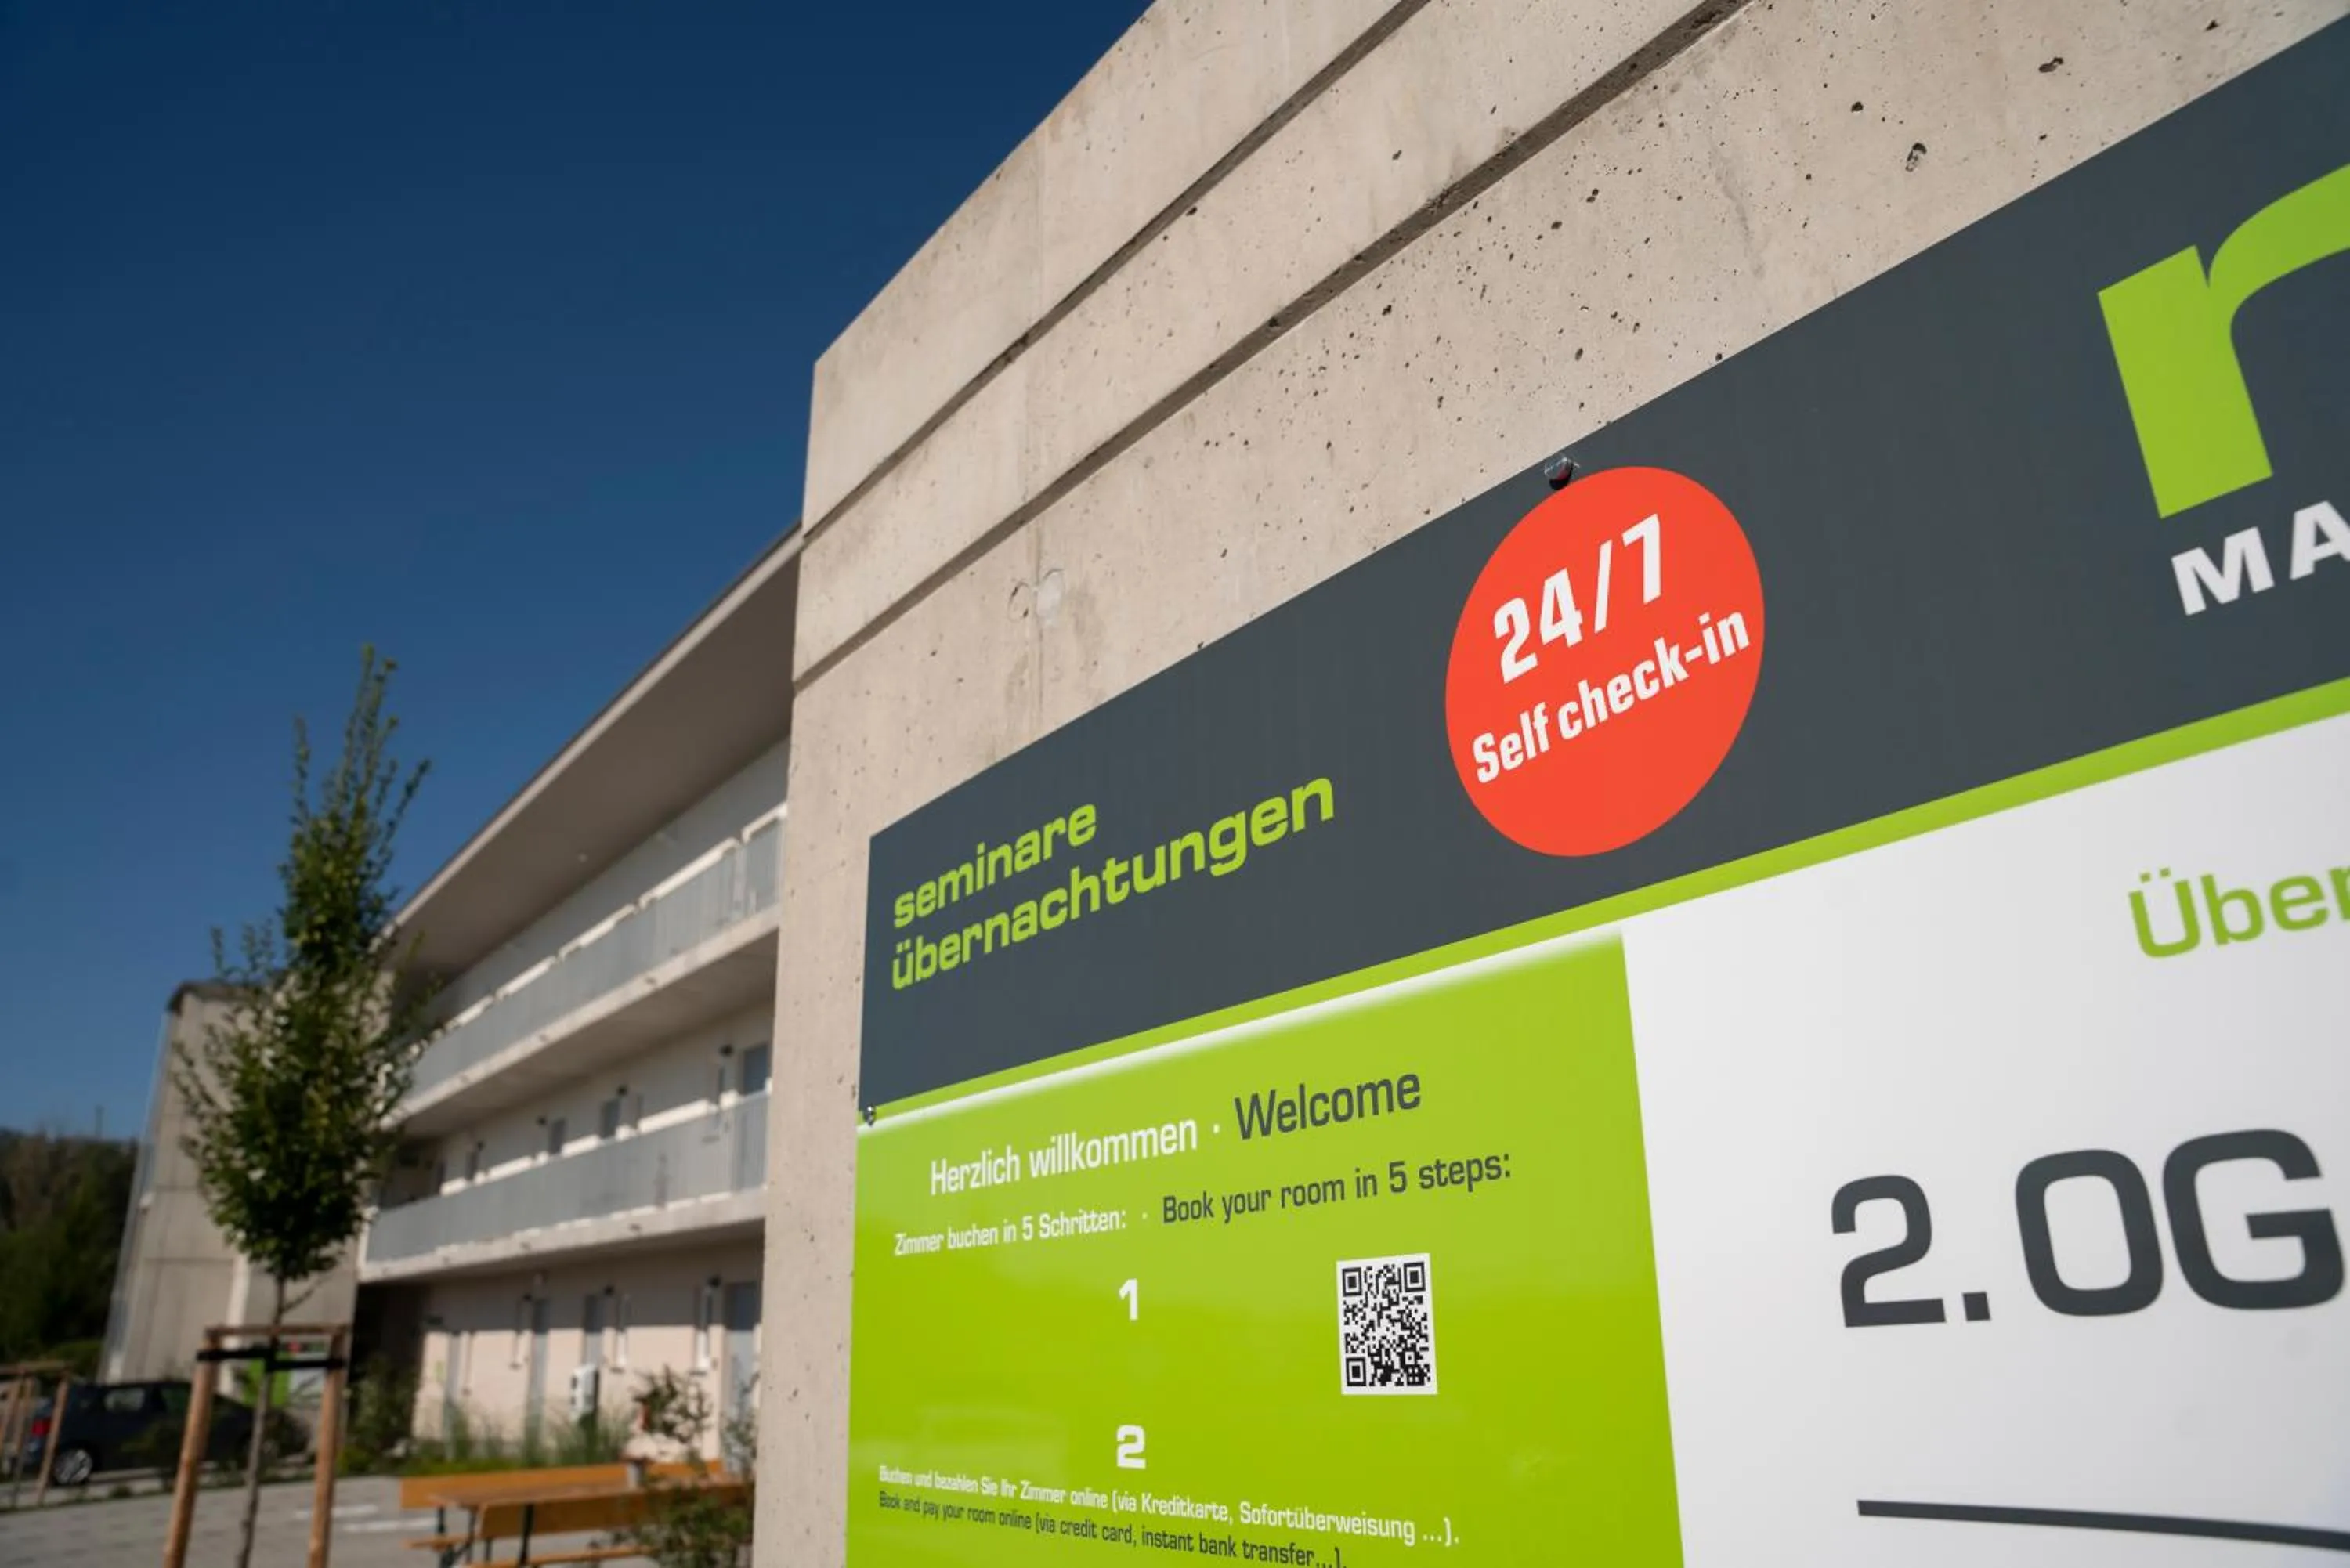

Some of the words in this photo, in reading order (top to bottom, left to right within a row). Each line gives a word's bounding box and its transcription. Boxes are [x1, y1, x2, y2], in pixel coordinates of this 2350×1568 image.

[1494, 513, 1661, 684] 24/7
[1473, 703, 1550, 783] Self
[1557, 611, 1750, 741] check-in
[891, 777, 1335, 990] übernachtungen
[893, 804, 1097, 928] seminare
[931, 1145, 1020, 1195] Herzlich
[1029, 1118, 1198, 1178] willkommen
[1234, 1073, 1422, 1140] Welcome
[895, 1232, 944, 1255] Zimmer
[948, 1226, 998, 1250] buchen
[1003, 1219, 1017, 1243] in
[1021, 1215, 1033, 1240] 5
[1039, 1209, 1126, 1238] Schritten:
[1162, 1191, 1214, 1223] Book
[1222, 1188, 1271, 1224] your
[1280, 1176, 1345, 1209] room
[1355, 1168, 1378, 1199] in
[1389, 1160, 1407, 1193] 5
[1419, 1153, 1511, 1192] steps:
[1119, 1278, 1138, 1321] 1
[1116, 1425, 1146, 1469] 2
[879, 1465, 913, 1485] Buchen
[914, 1470, 933, 1488] und
[934, 1470, 978, 1493] bezahlen
[981, 1476, 998, 1496] Sie
[1000, 1477, 1017, 1498] Ihr
[1020, 1479, 1065, 1504] Zimmer
[1071, 1487, 1108, 1509] online
[1112, 1490, 1137, 1513] (via
[1141, 1491, 1233, 1526] Kreditkarte,
[1240, 1501, 1415, 1547] Sofortüberweisung
[880, 1490, 900, 1509] Book
[903, 1496, 920, 1512] and
[923, 1501, 940, 1520] pay
[942, 1503, 964, 1521] your
[967, 1507, 996, 1524] room
[999, 1509, 1032, 1529] online
[1035, 1512, 1055, 1534] (via
[1060, 1518, 1097, 1539] credit
[1102, 1523, 1137, 1548] card,
[1141, 1525, 1195, 1552] instant
[1199, 1531, 1237, 1559] bank
